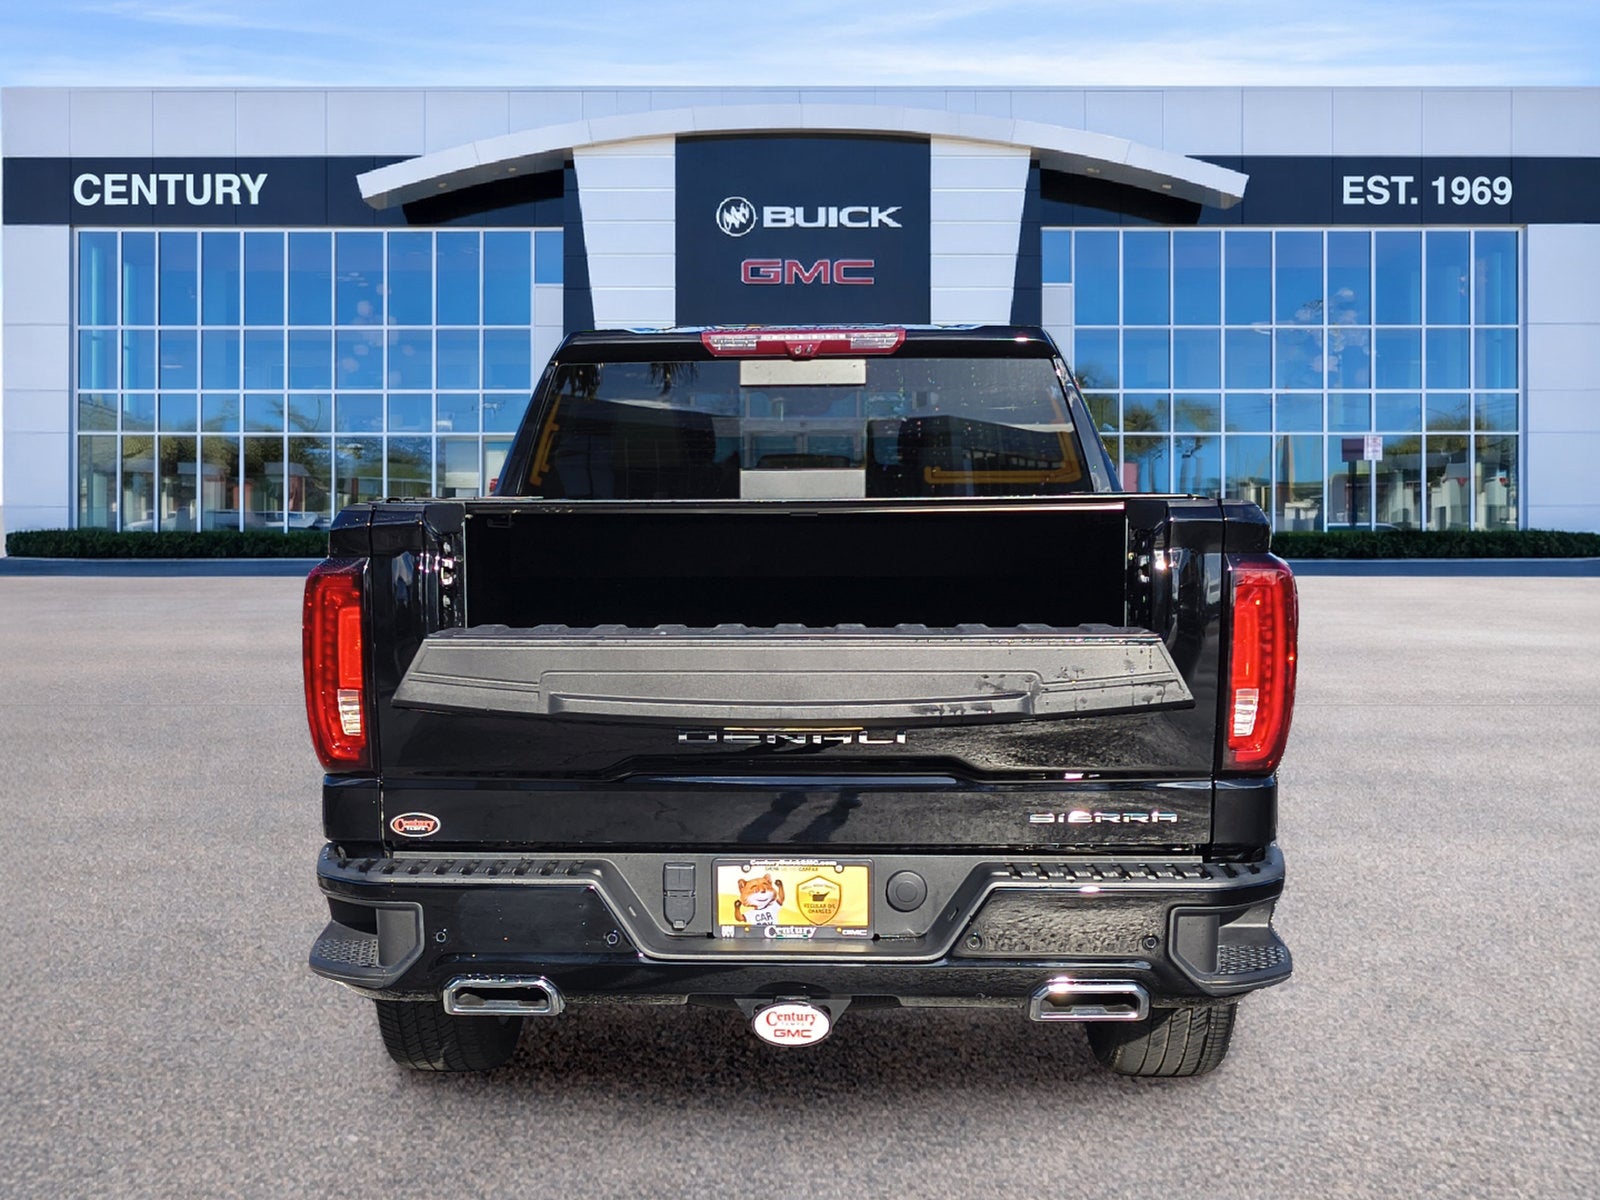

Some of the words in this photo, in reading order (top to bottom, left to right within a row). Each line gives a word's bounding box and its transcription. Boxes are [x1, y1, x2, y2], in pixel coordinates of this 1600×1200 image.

[73, 173, 268, 206] CENTURY
[1342, 175, 1418, 205] EST.
[1431, 175, 1513, 206] 1969
[763, 206, 903, 228] BUICK
[741, 258, 875, 285] GMC
[1029, 811, 1179, 824] SIERRA
[755, 911, 773, 922] CAR
[764, 925, 817, 939] Century
[766, 1011, 816, 1026] Century
[774, 1029, 813, 1038] GMC
